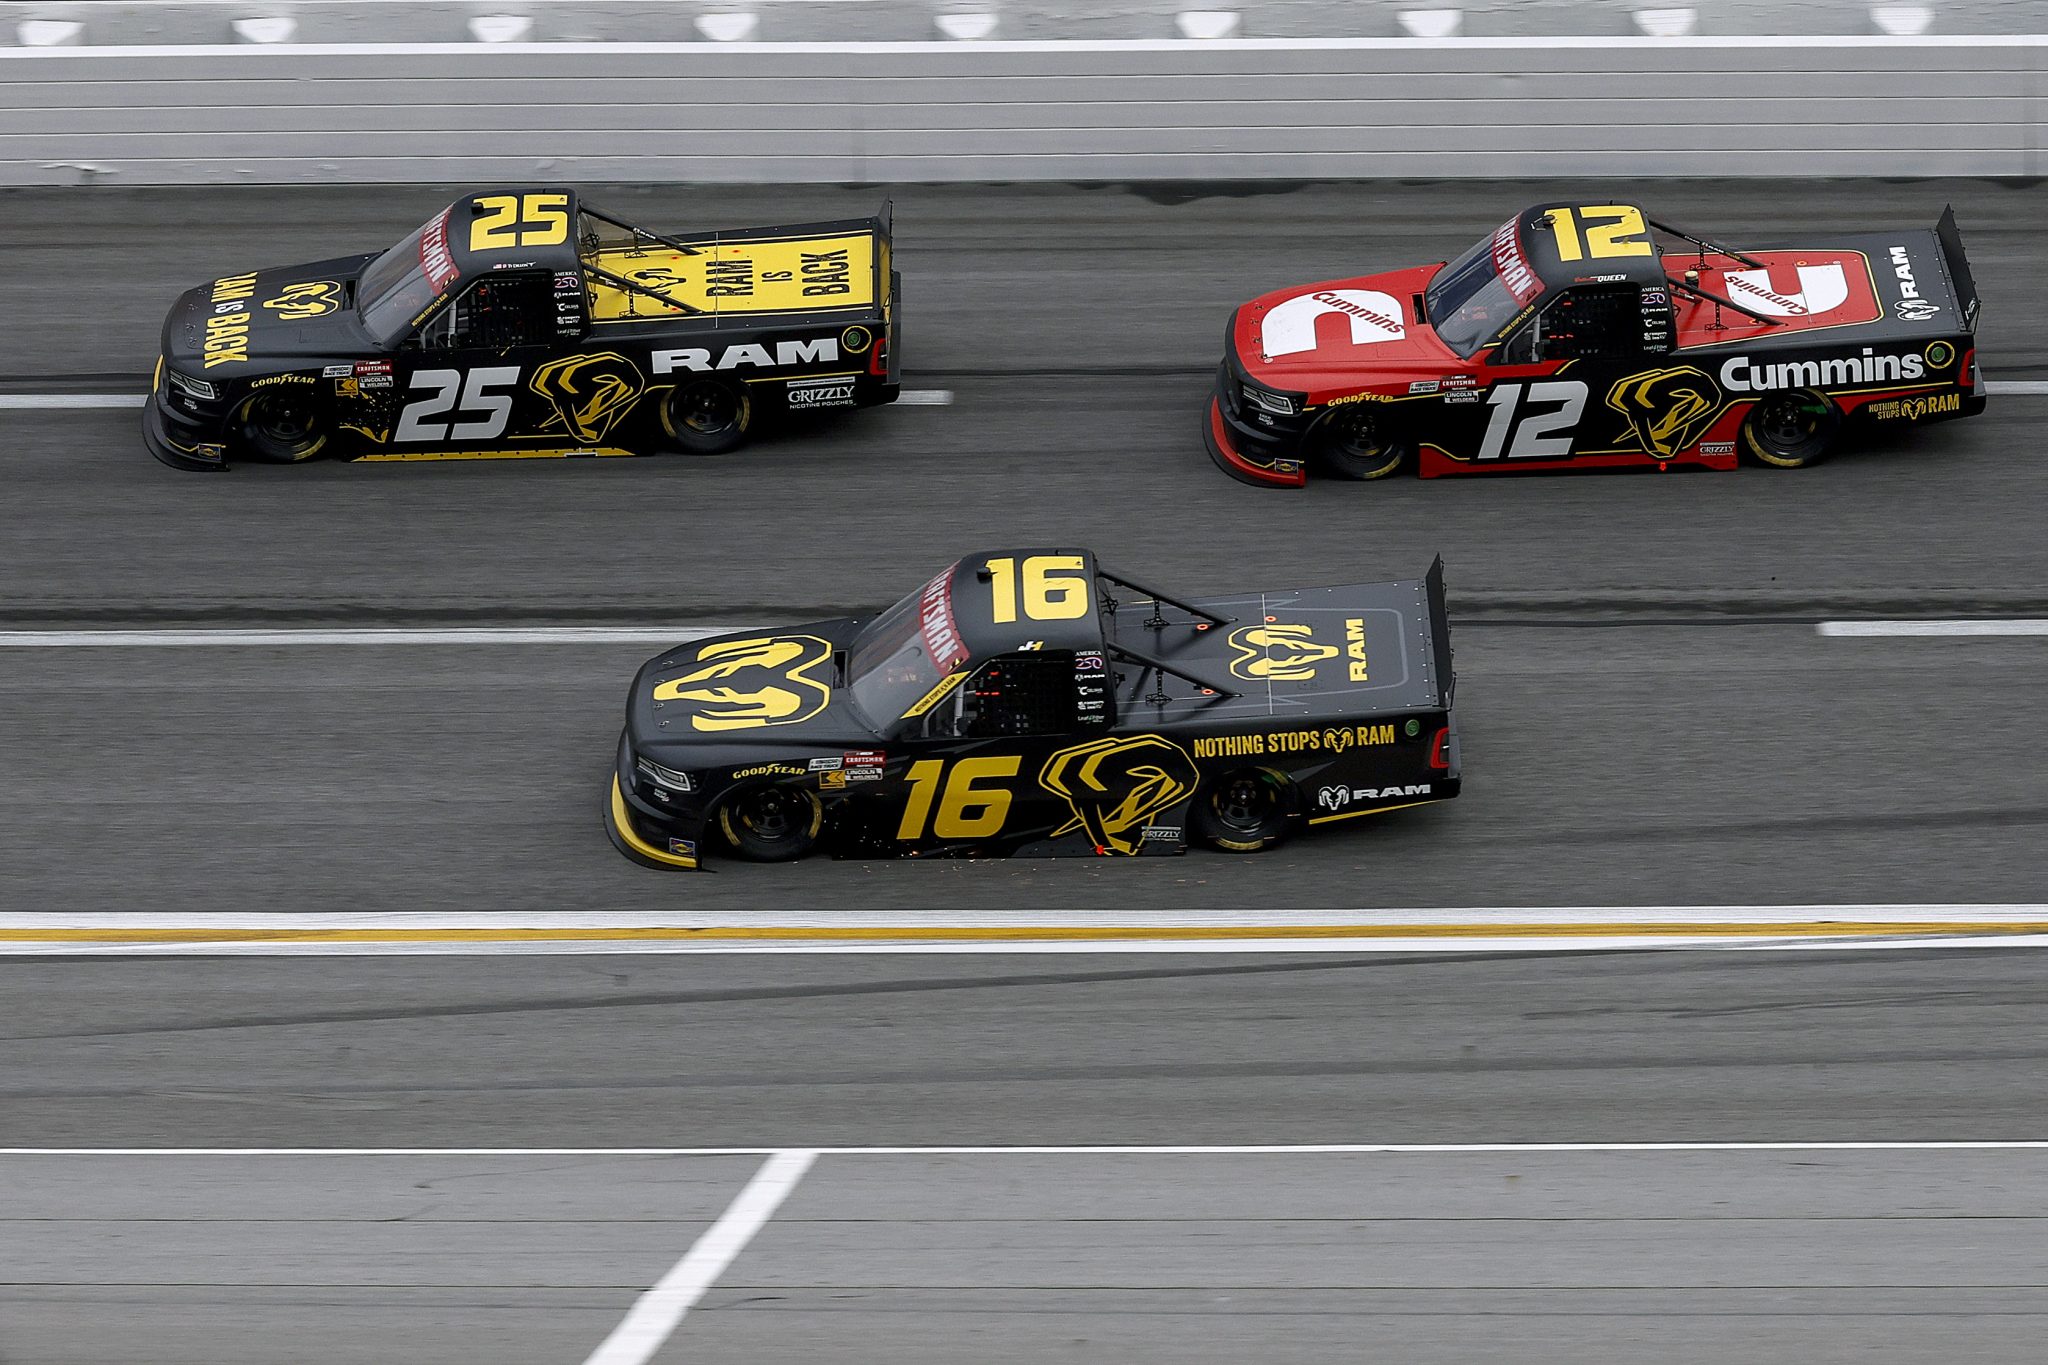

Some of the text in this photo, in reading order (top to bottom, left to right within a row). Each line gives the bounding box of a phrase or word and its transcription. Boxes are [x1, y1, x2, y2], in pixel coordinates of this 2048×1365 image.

[470, 194, 568, 251] 25
[1544, 205, 1652, 262] 12
[555, 277, 578, 288] 250
[706, 260, 753, 296] RAM
[761, 271, 792, 282] IS
[801, 249, 850, 296] BACK
[1597, 274, 1627, 282] QUEEN
[1889, 246, 1919, 298] RAM
[215, 300, 244, 313] IS
[1312, 292, 1405, 333] Cummins
[1641, 293, 1665, 304] 250
[1725, 276, 1808, 314] Cummins
[204, 312, 250, 369] BACK
[652, 338, 838, 374] RAM
[251, 373, 315, 388] GOODYEAR
[1720, 348, 1924, 391] Cummins
[394, 366, 521, 442] 25
[788, 386, 855, 402] GRIZZLY
[1328, 392, 1393, 406] GOODYEAR
[1869, 401, 1899, 413] NOTHING
[1878, 394, 1959, 419] STOPS RAM
[1478, 381, 1588, 459] 12
[985, 556, 1088, 624] 16
[1075, 657, 1102, 669] 250
[1345, 618, 1367, 681] RAM
[1194, 724, 1394, 758] NOTHING STOPS RAM
[732, 763, 805, 779] GOODYEAR
[896, 756, 1022, 839] 16
[1353, 784, 1430, 800] RAM
